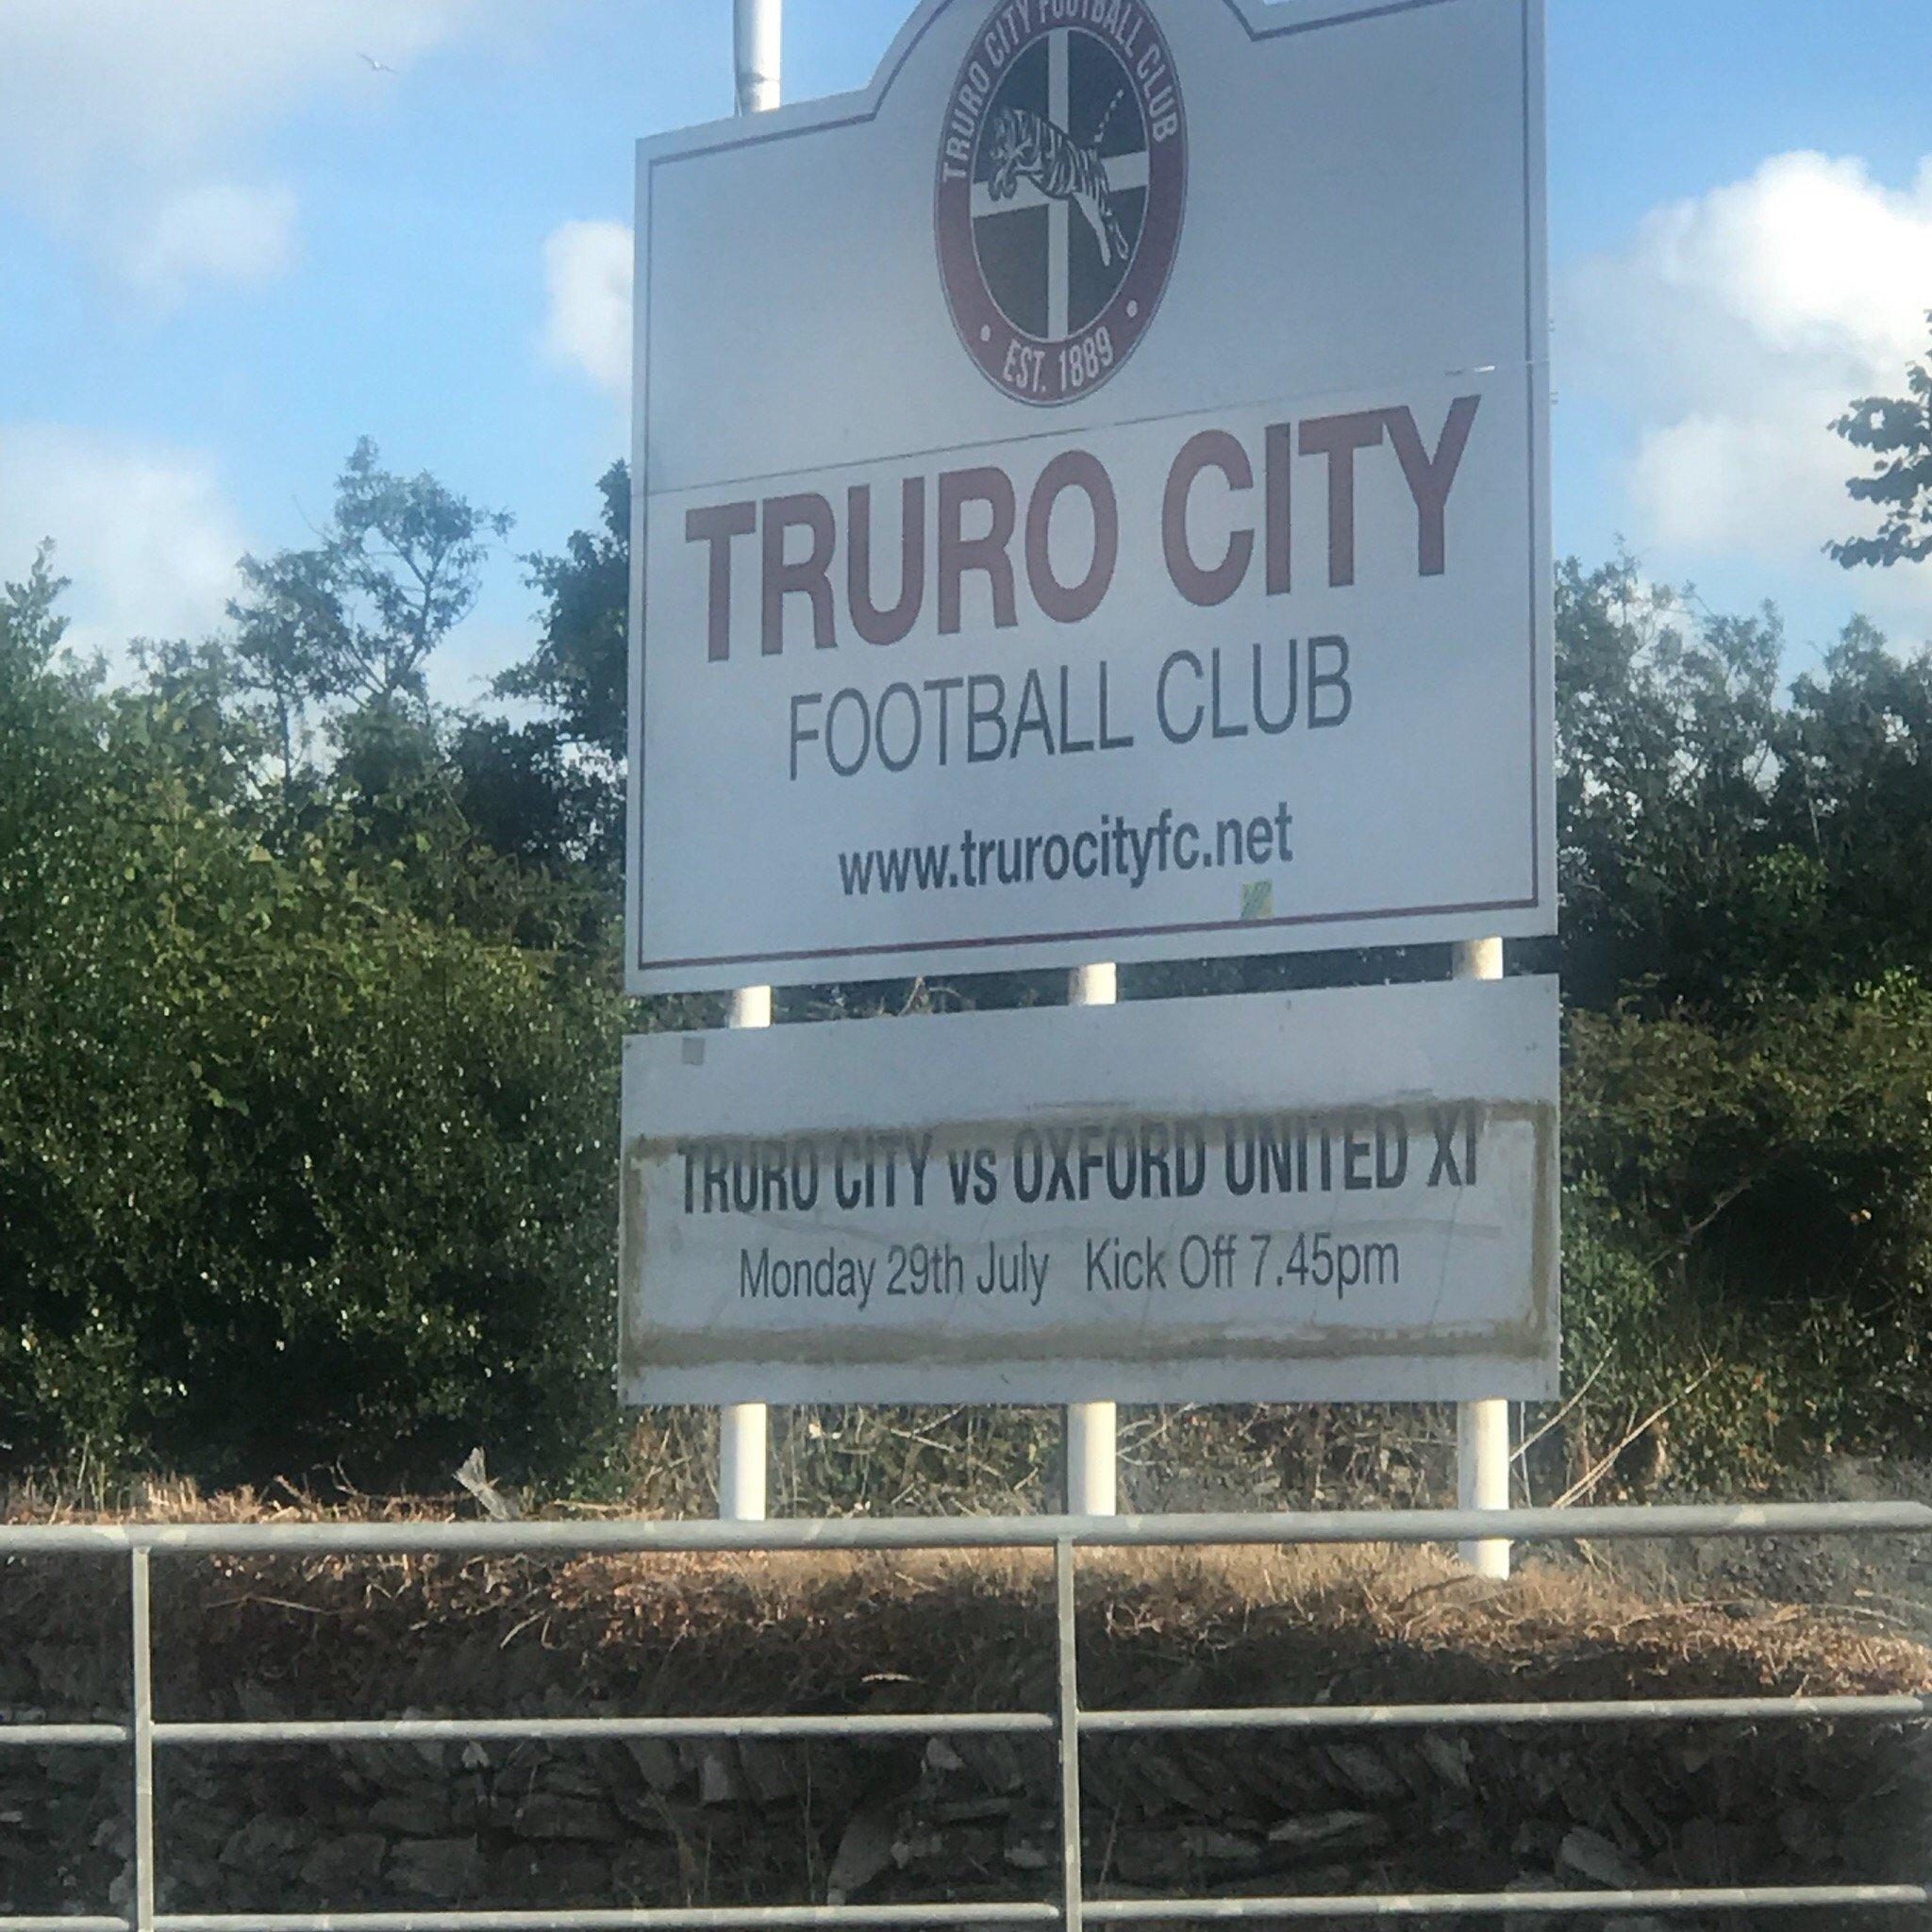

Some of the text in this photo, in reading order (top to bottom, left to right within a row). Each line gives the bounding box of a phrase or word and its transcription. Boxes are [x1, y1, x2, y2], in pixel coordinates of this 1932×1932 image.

[943, 61, 990, 182] TRURO
[984, 0, 1031, 68] CITY
[1137, 43, 1178, 142] CLUB
[1003, 326, 1114, 392] EST. 1889
[684, 393, 1482, 663] TRURO CITY
[789, 634, 1353, 781] FOOTBALL CLUB
[838, 801, 1293, 897] www.trurocityfc.net
[677, 1100, 1476, 1213] TRURO CITY vs OXFORD UNITED XI
[741, 1231, 1399, 1311] Monday 29th July Kick Off 7.45pm
